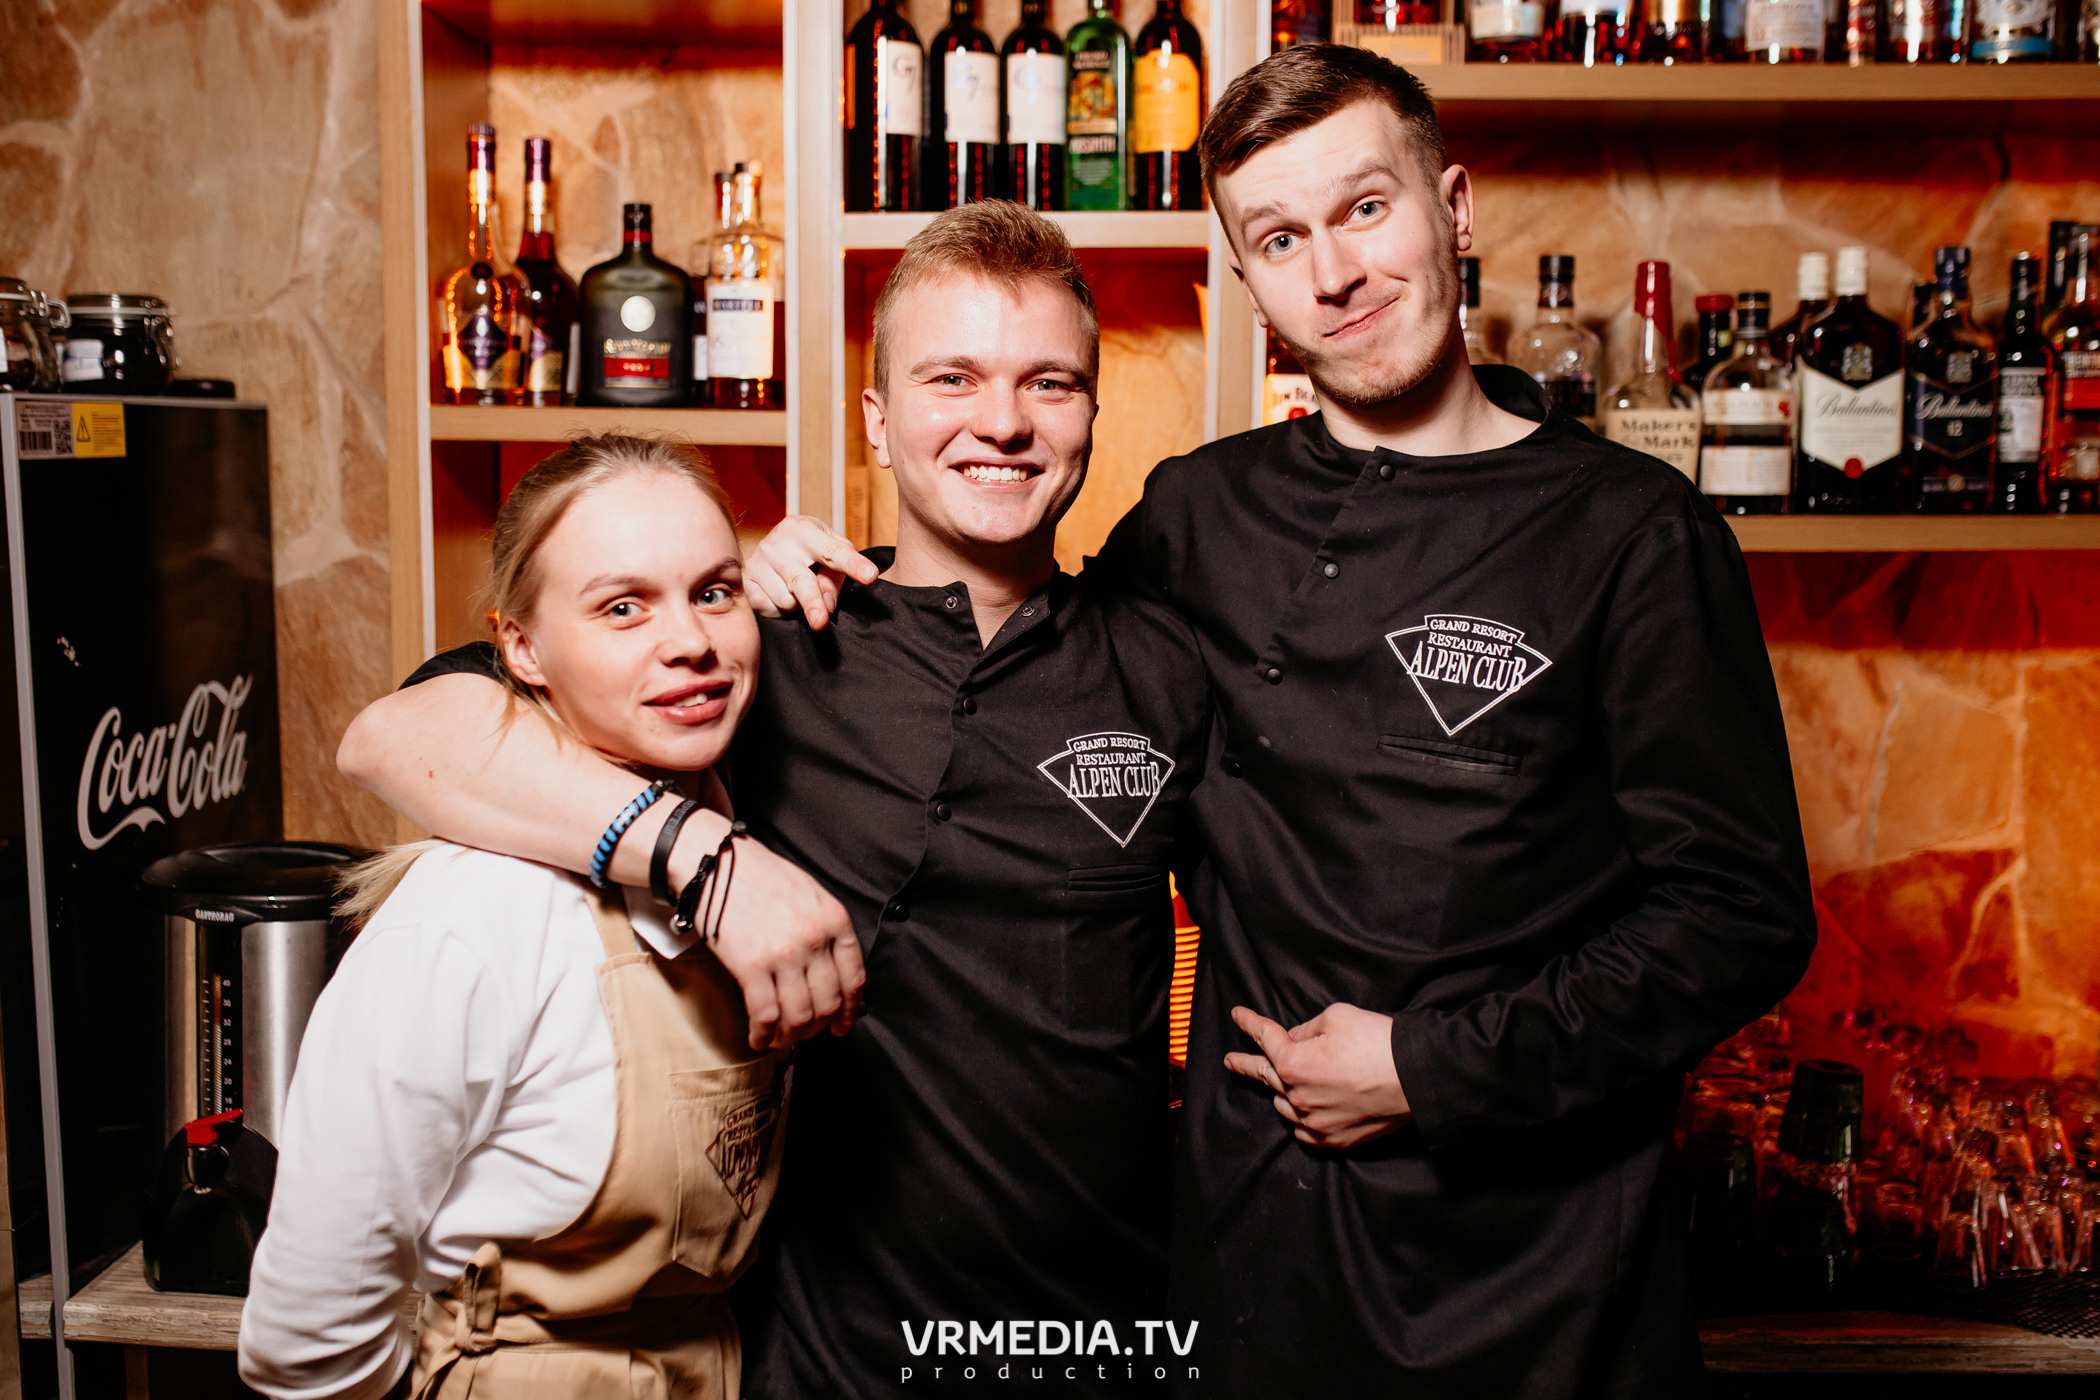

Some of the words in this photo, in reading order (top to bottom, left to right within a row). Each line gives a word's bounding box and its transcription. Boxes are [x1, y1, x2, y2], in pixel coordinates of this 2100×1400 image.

[1644, 435, 1695, 449] Mark
[1430, 619, 1470, 632] GRAND
[1472, 623, 1517, 644] RESORT
[1427, 632, 1512, 657] RESTAURANT
[1407, 640, 1474, 684] ALPEN
[1473, 656, 1527, 692] CLUB
[1073, 738, 1108, 752] GRAND
[1110, 737, 1146, 750] RESORT
[1076, 752, 1146, 766] RESTAURANT
[1068, 764, 1123, 798] ALPEN
[1124, 761, 1161, 796] CLUB
